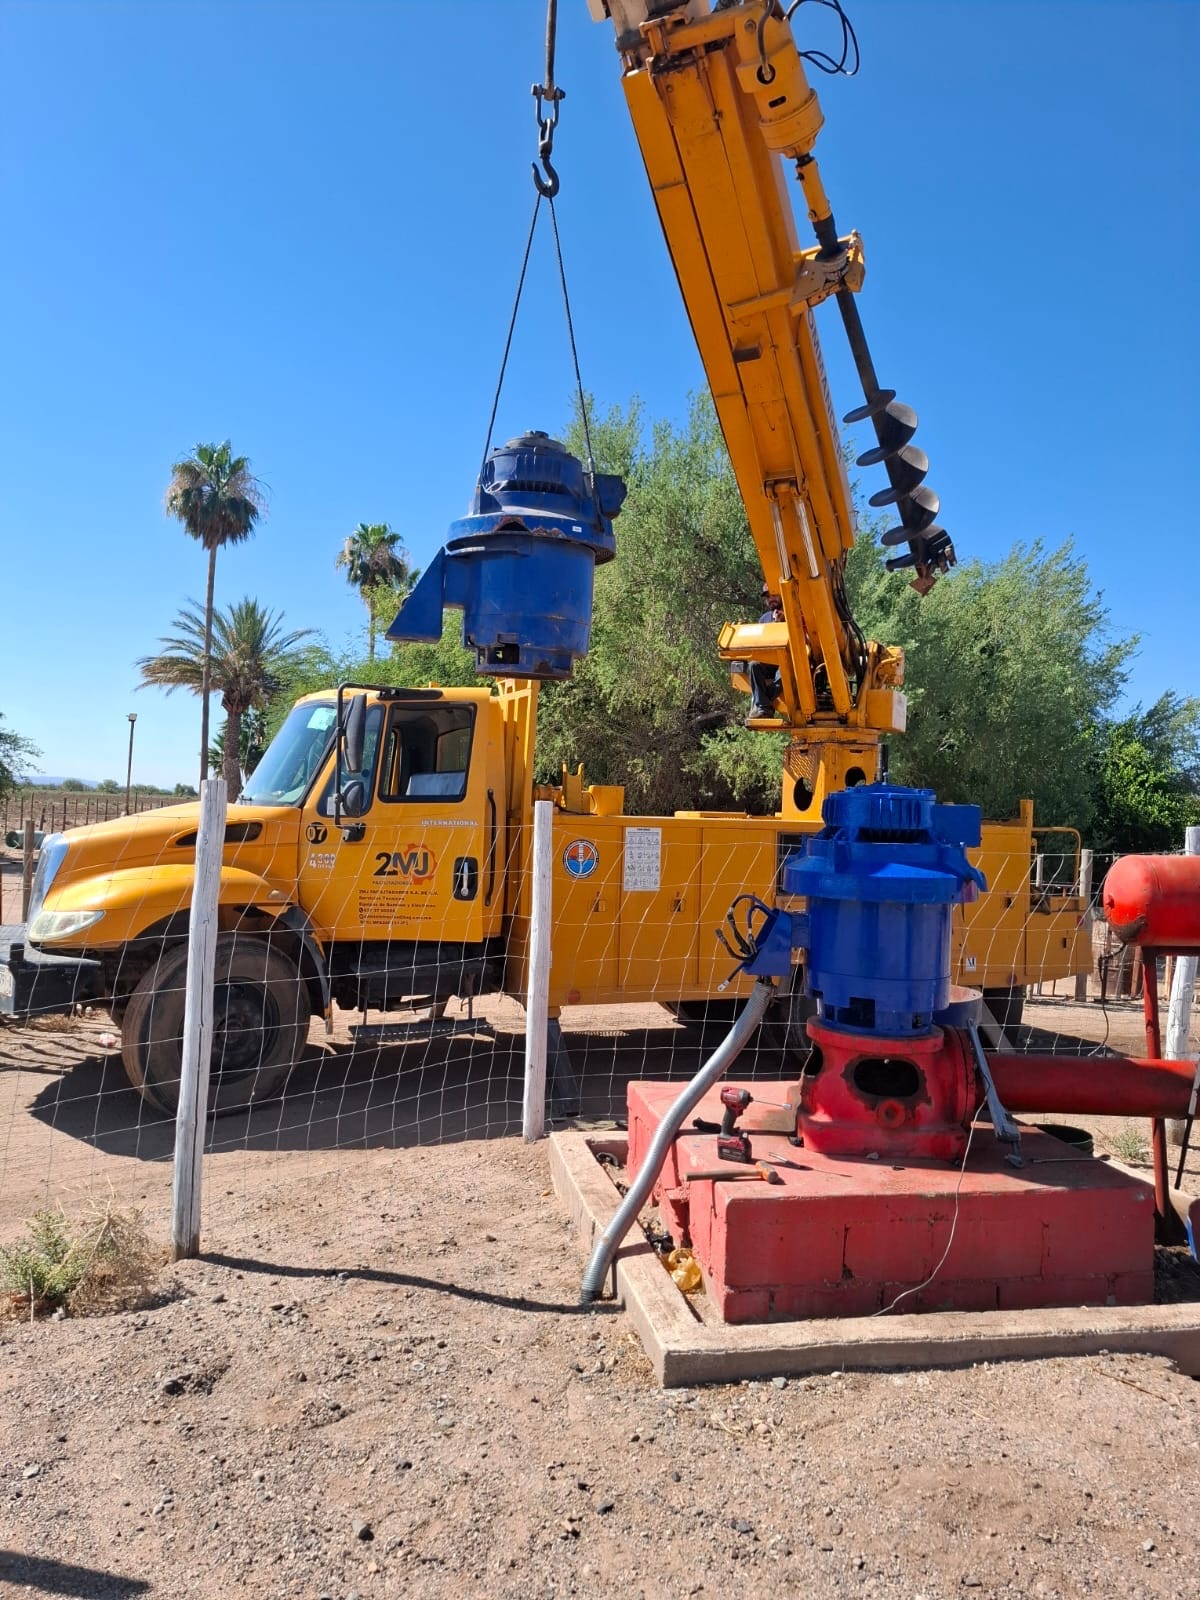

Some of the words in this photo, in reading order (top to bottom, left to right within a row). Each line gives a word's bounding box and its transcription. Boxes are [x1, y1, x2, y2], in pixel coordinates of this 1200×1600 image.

[807, 308, 843, 464] OMMANDER
[421, 818, 479, 826] INTERNATIONAL
[307, 826, 326, 841] 07
[309, 853, 336, 868] 4300
[373, 851, 429, 876] 2MJ
